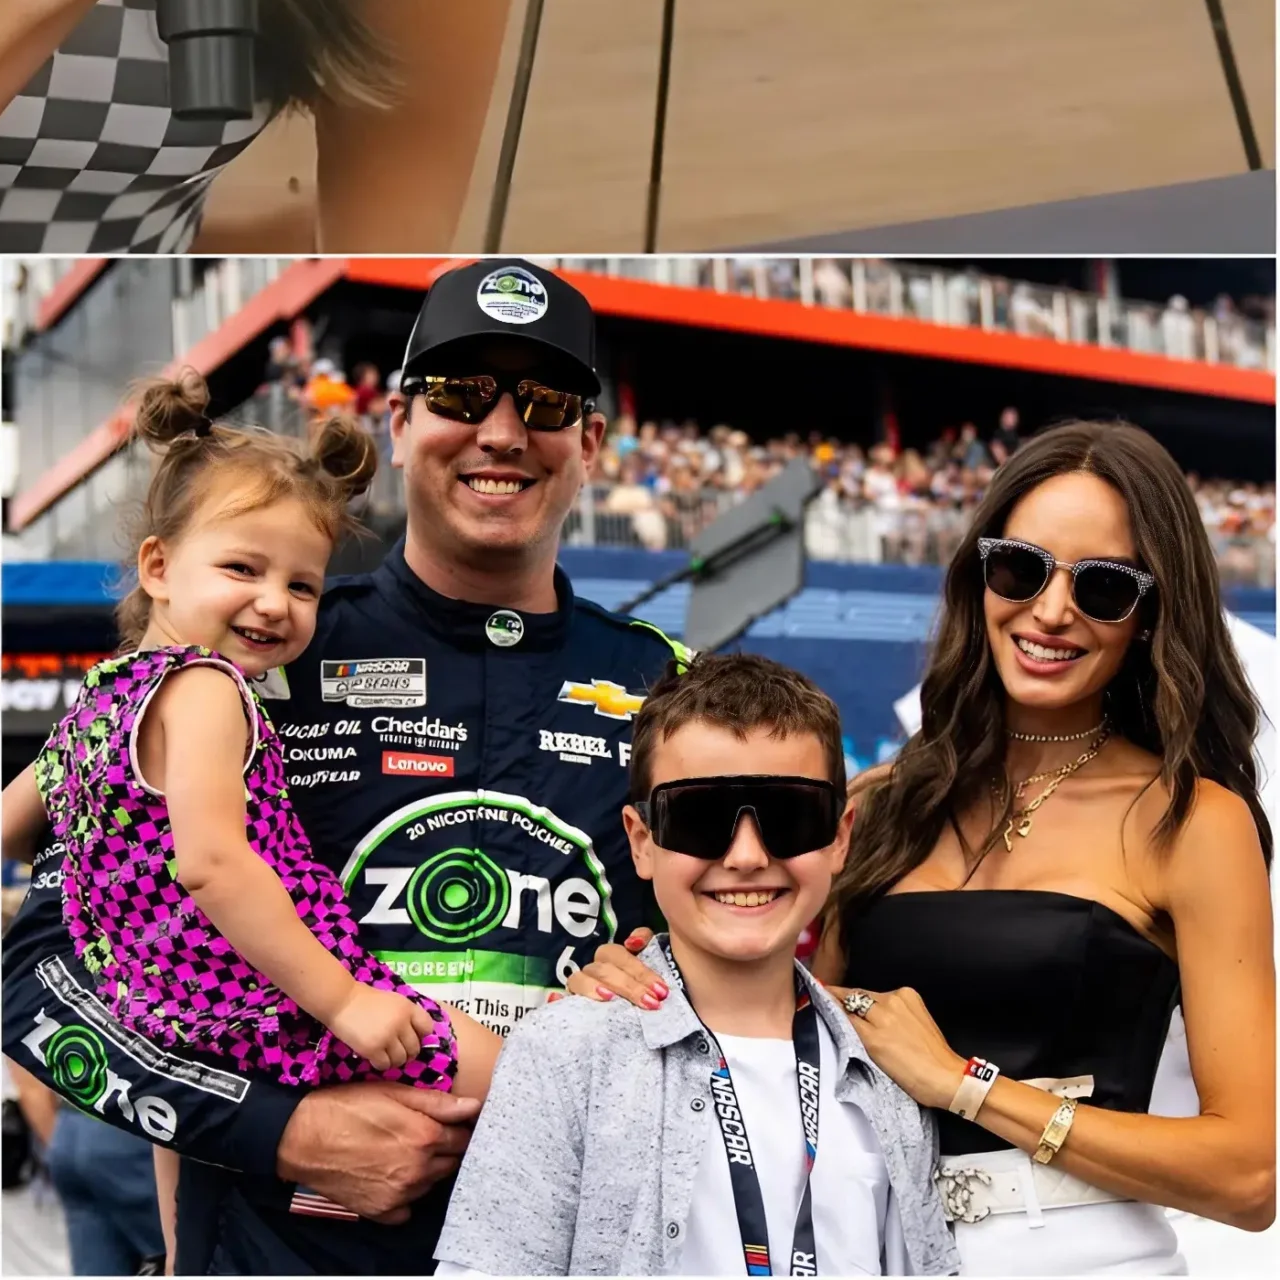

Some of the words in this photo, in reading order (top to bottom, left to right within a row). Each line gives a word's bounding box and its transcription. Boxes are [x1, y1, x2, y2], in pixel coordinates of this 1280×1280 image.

[334, 720, 362, 735] OIL
[371, 716, 468, 742] Cheddar's
[538, 729, 613, 758] REBEL
[406, 823, 426, 841] 20
[358, 847, 601, 943] zone
[474, 998, 509, 1017] This
[798, 1060, 820, 1148] NASCAR
[711, 1071, 753, 1166] NASCAR
